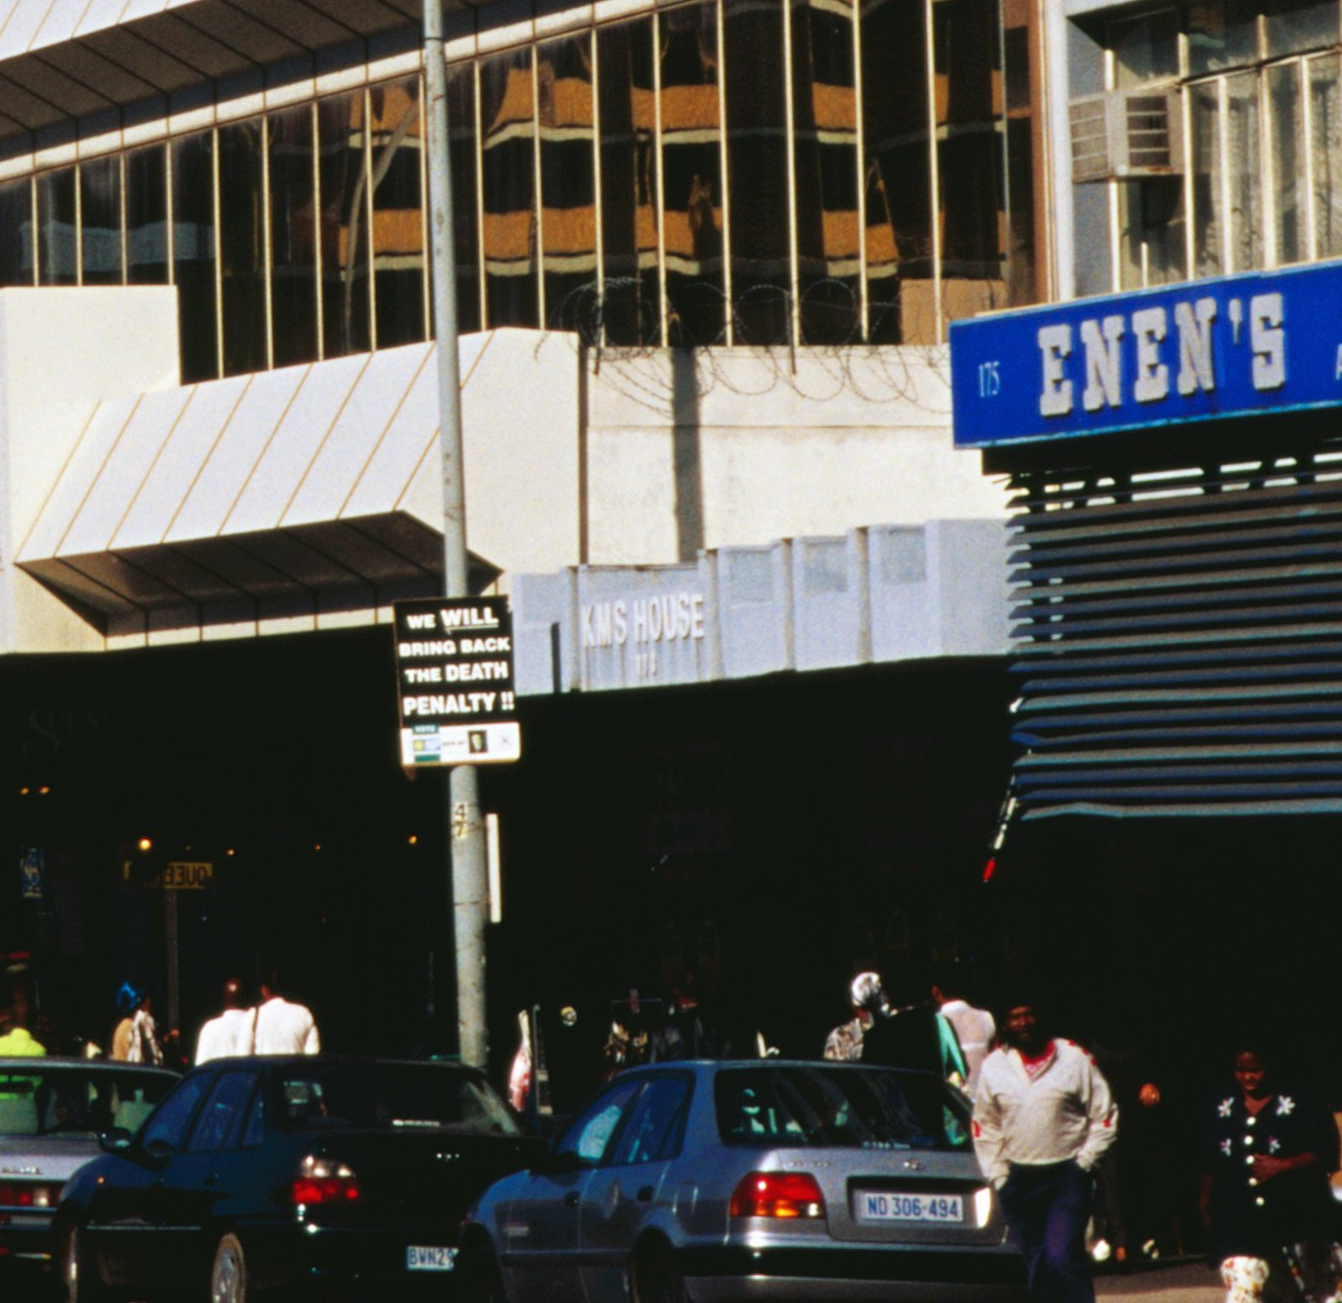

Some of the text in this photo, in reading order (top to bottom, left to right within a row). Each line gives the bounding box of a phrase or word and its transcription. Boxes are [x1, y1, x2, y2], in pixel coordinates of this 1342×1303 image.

[978, 361, 1001, 397] 175
[1037, 292, 1286, 417] ENEN'S
[407, 607, 499, 630] WE WILL
[581, 591, 705, 648] KMS HOUSE
[398, 637, 511, 657] BRING BACK
[404, 661, 509, 683] THE DEATH
[402, 692, 497, 716] PENALTY
[867, 1195, 959, 1217] ND 306-494
